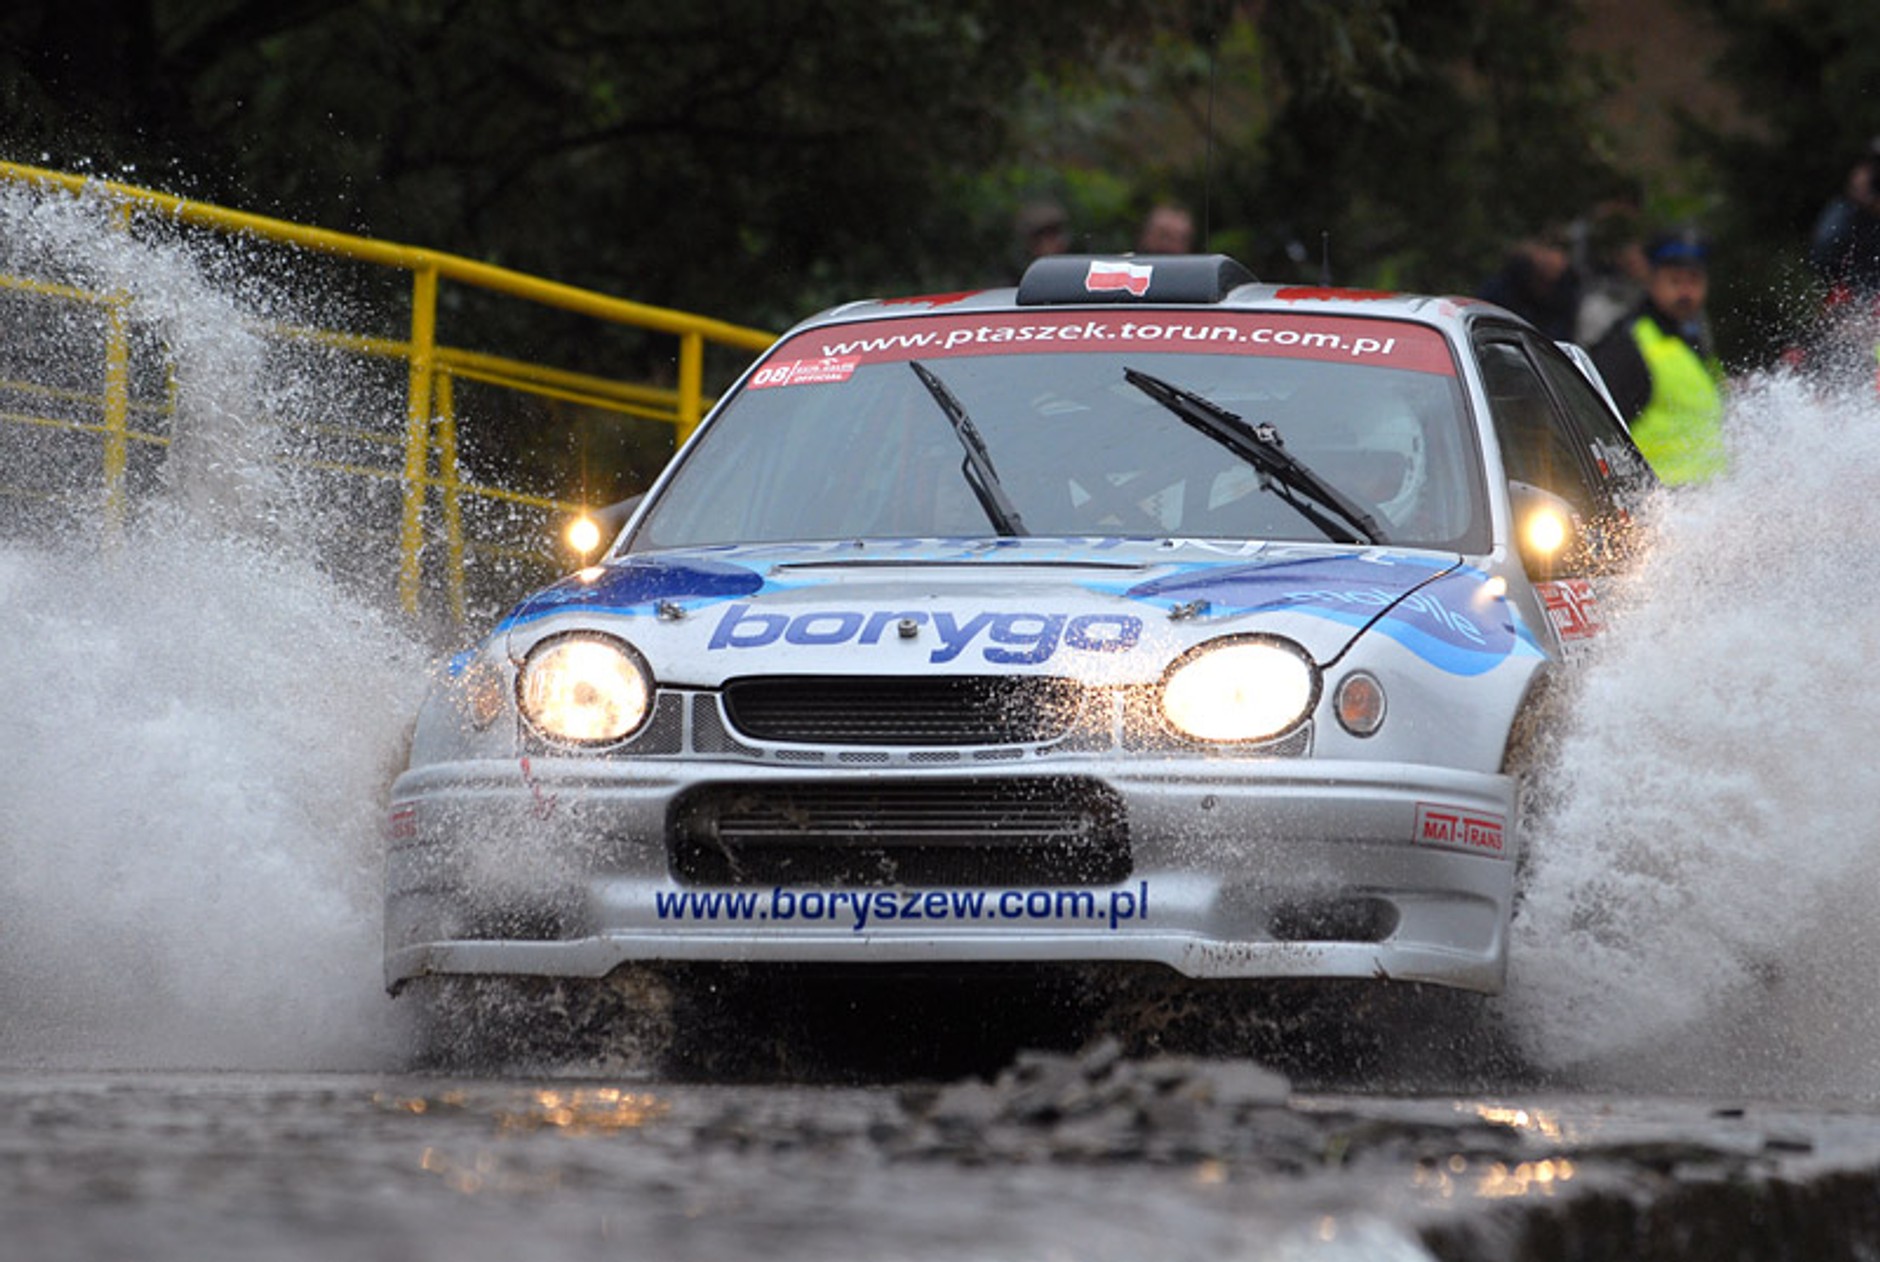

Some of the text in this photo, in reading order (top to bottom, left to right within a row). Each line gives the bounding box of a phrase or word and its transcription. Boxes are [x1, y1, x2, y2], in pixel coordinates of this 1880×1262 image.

[822, 321, 1396, 356] www.ptaszek.torun.com.pl
[707, 604, 1144, 664] borygo
[655, 881, 1149, 930] www.boryszew.com.pl
